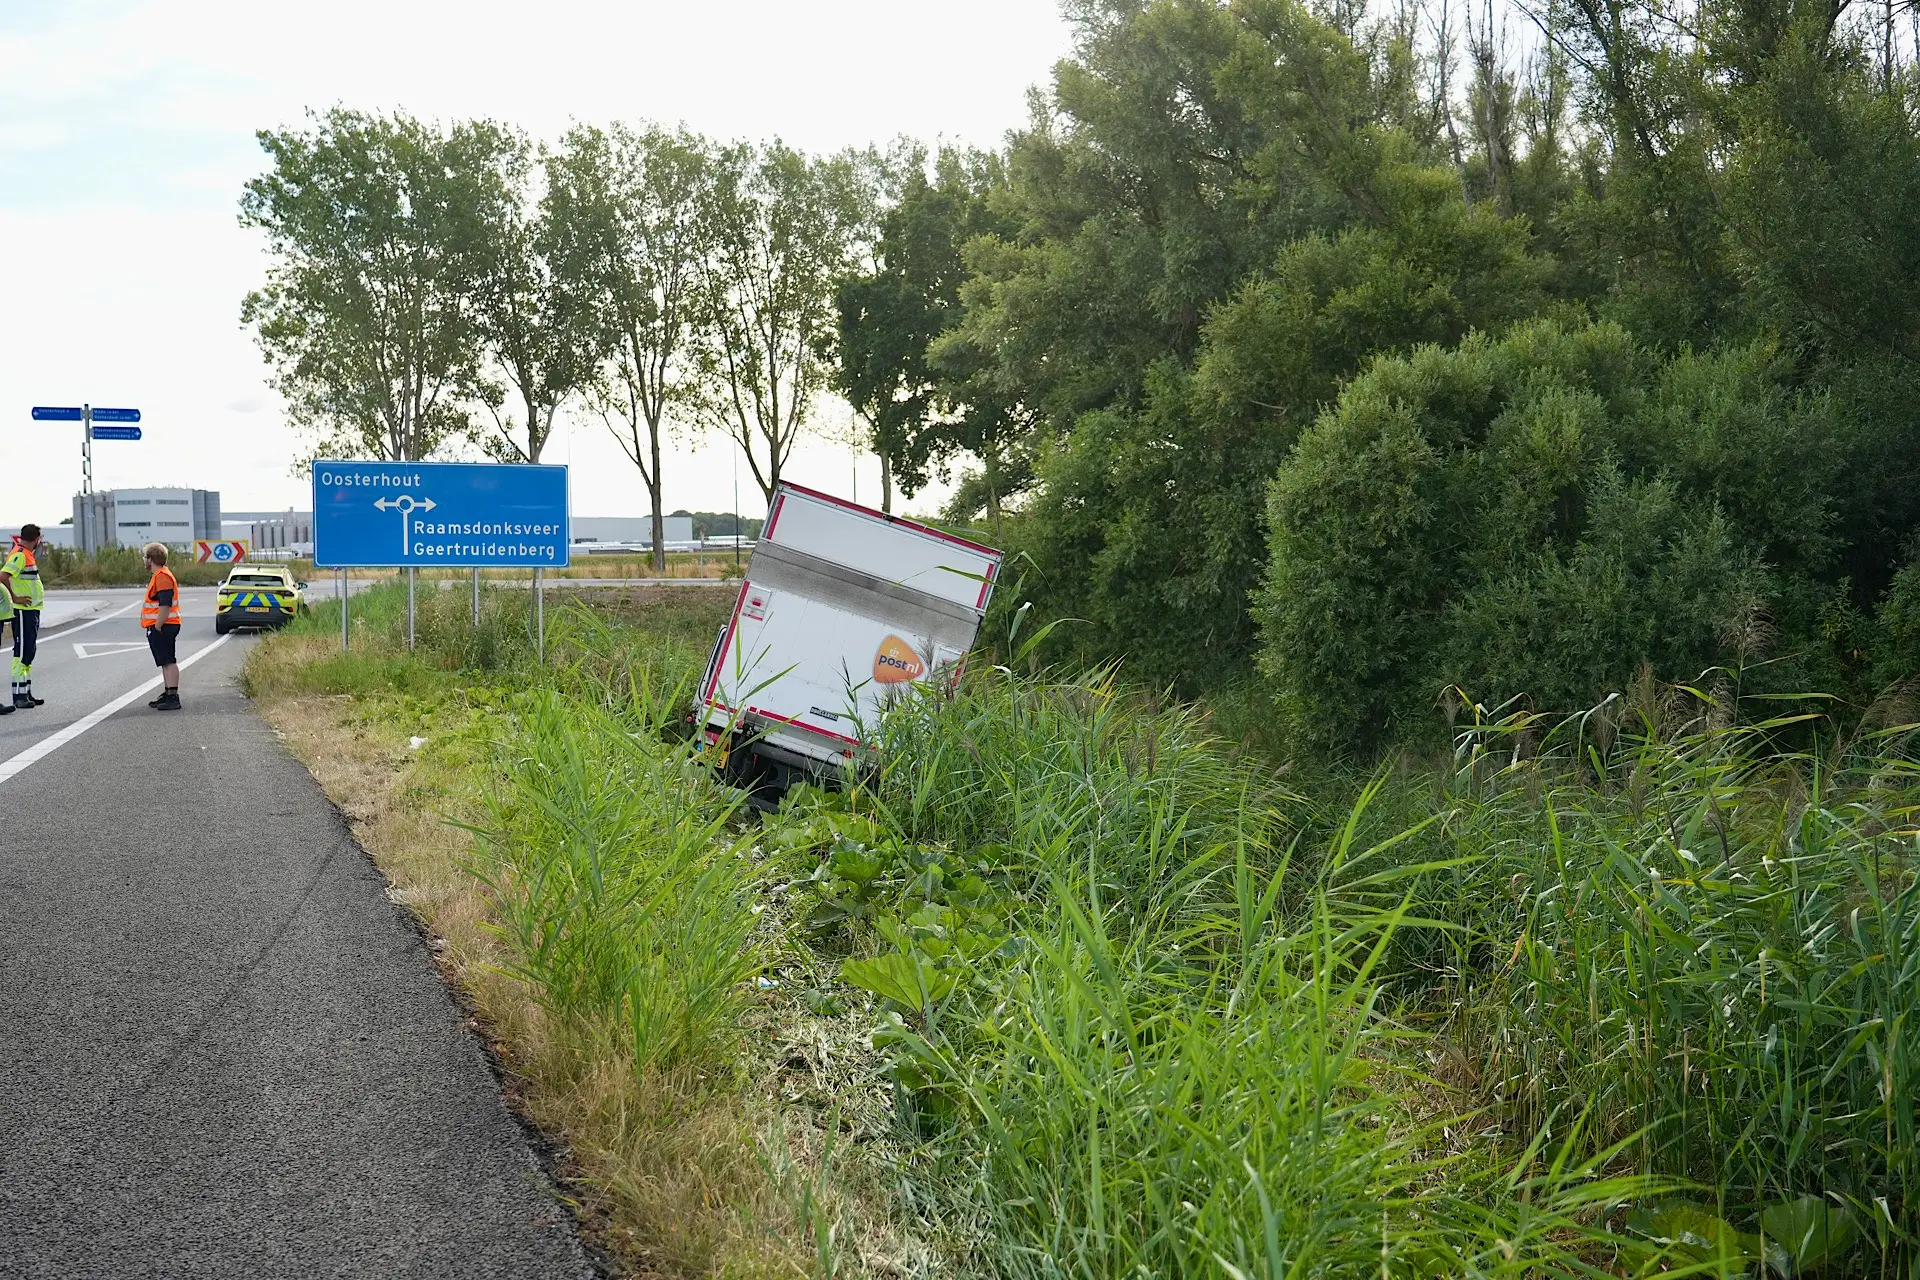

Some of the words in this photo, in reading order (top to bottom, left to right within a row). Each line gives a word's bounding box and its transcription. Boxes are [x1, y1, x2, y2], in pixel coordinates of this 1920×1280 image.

[321, 471, 421, 487] Oosterhout
[413, 520, 560, 536] Raamsdonksveer
[413, 542, 555, 560] Geertruidenberg
[878, 654, 920, 674] postnl
